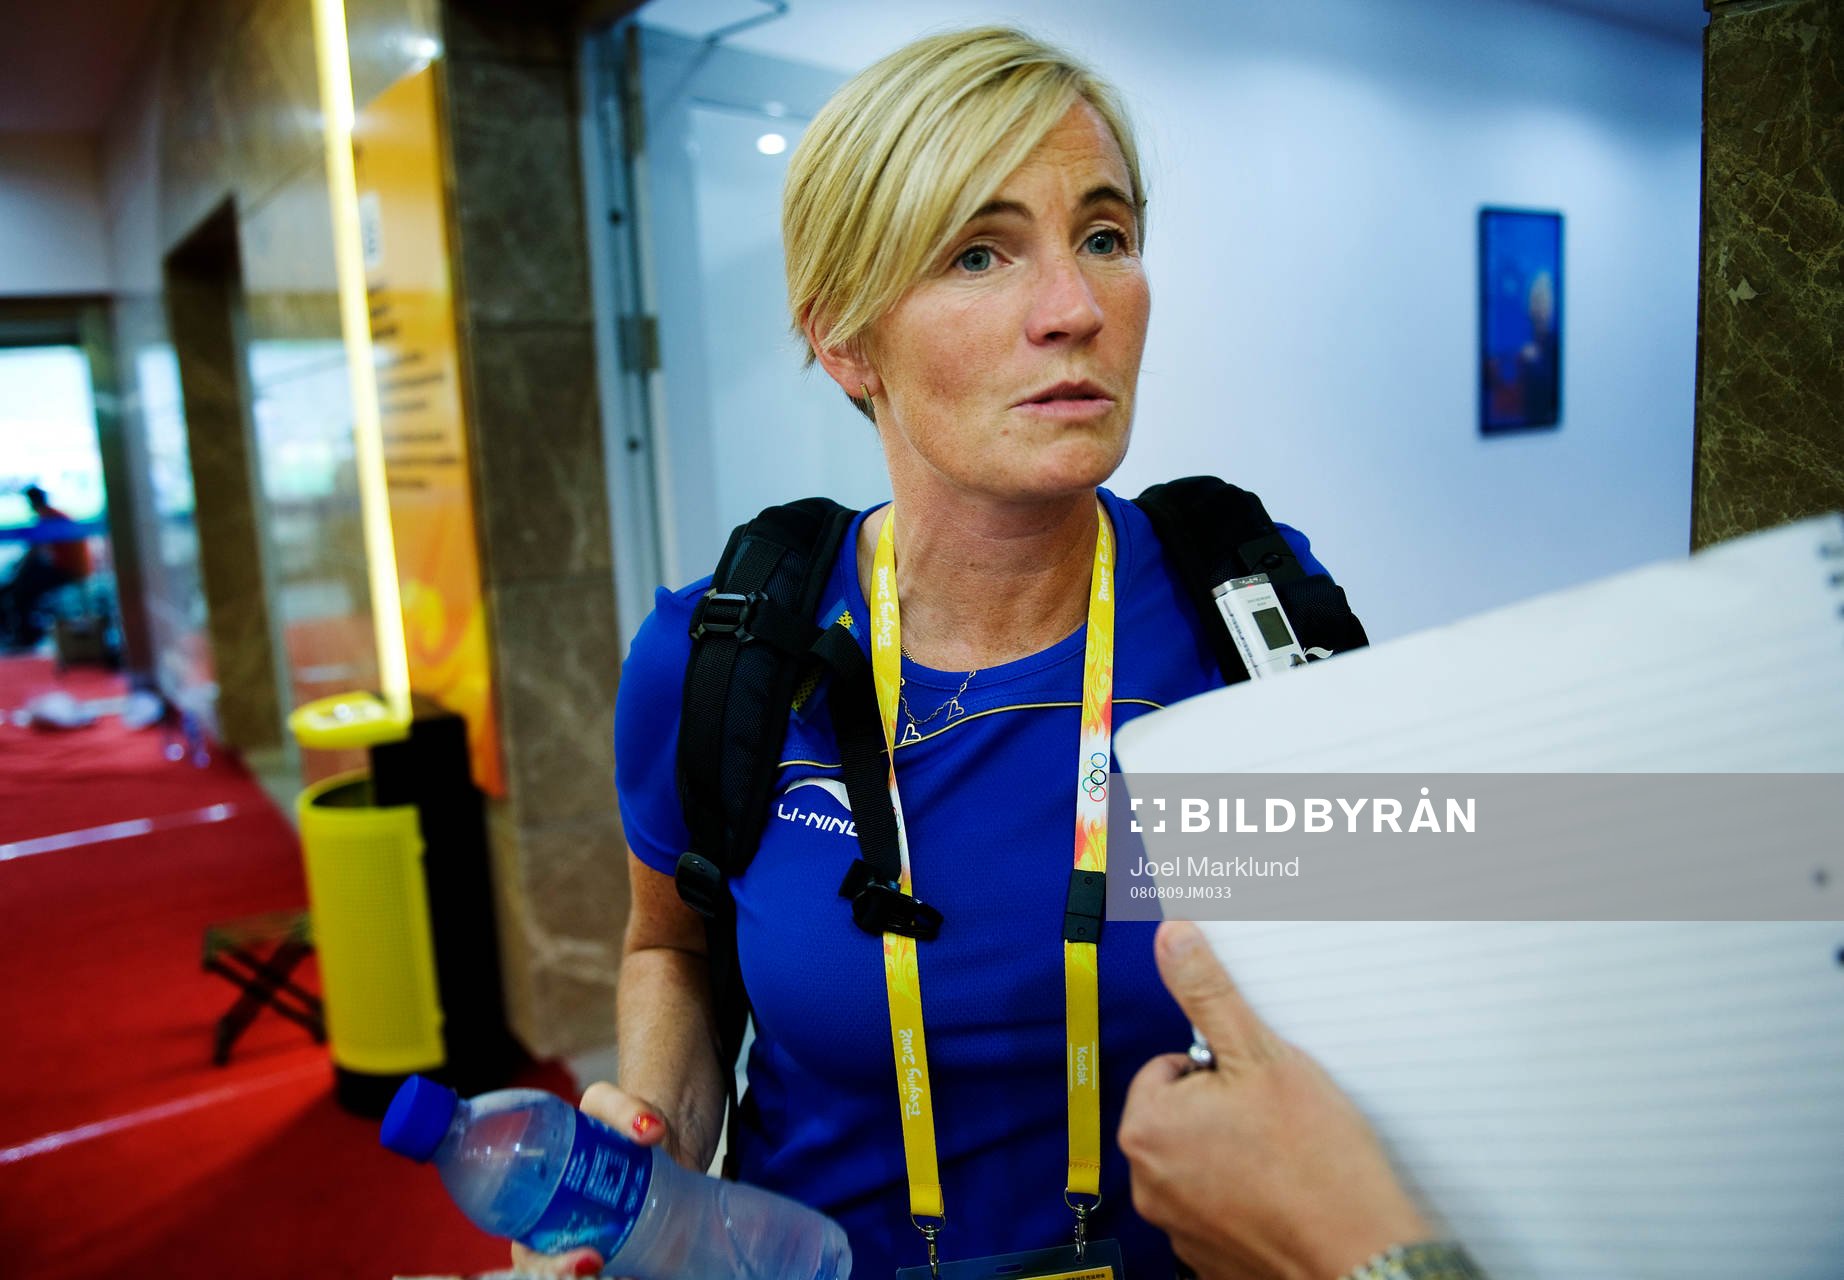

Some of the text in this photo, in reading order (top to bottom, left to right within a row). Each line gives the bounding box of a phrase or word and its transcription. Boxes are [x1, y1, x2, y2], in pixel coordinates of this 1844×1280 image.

[876, 565, 895, 652] Beijing 2008
[898, 1028, 922, 1121] Beijing 2008
[1076, 1046, 1089, 1086] Kodak
